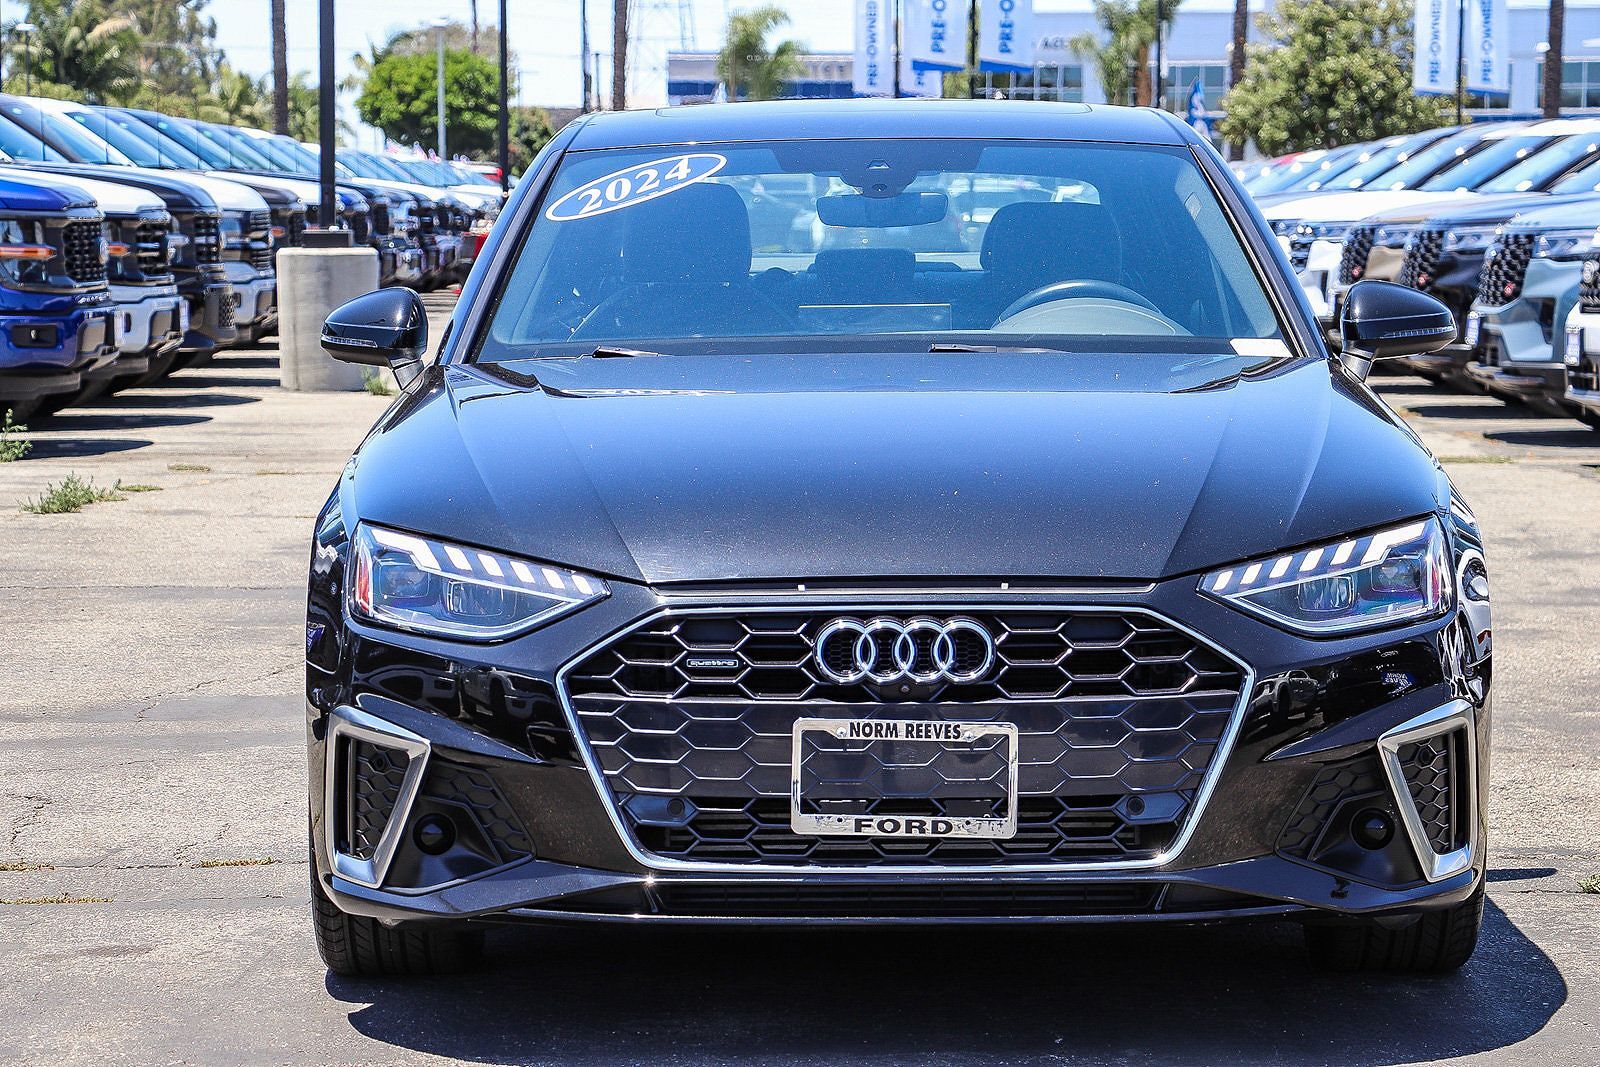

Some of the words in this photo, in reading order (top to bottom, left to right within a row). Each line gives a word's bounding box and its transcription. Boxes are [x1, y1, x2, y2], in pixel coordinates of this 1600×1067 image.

[577, 157, 692, 216] 2024
[849, 722, 899, 738] NORM
[905, 723, 961, 740] REEVES
[853, 818, 954, 835] FORD
